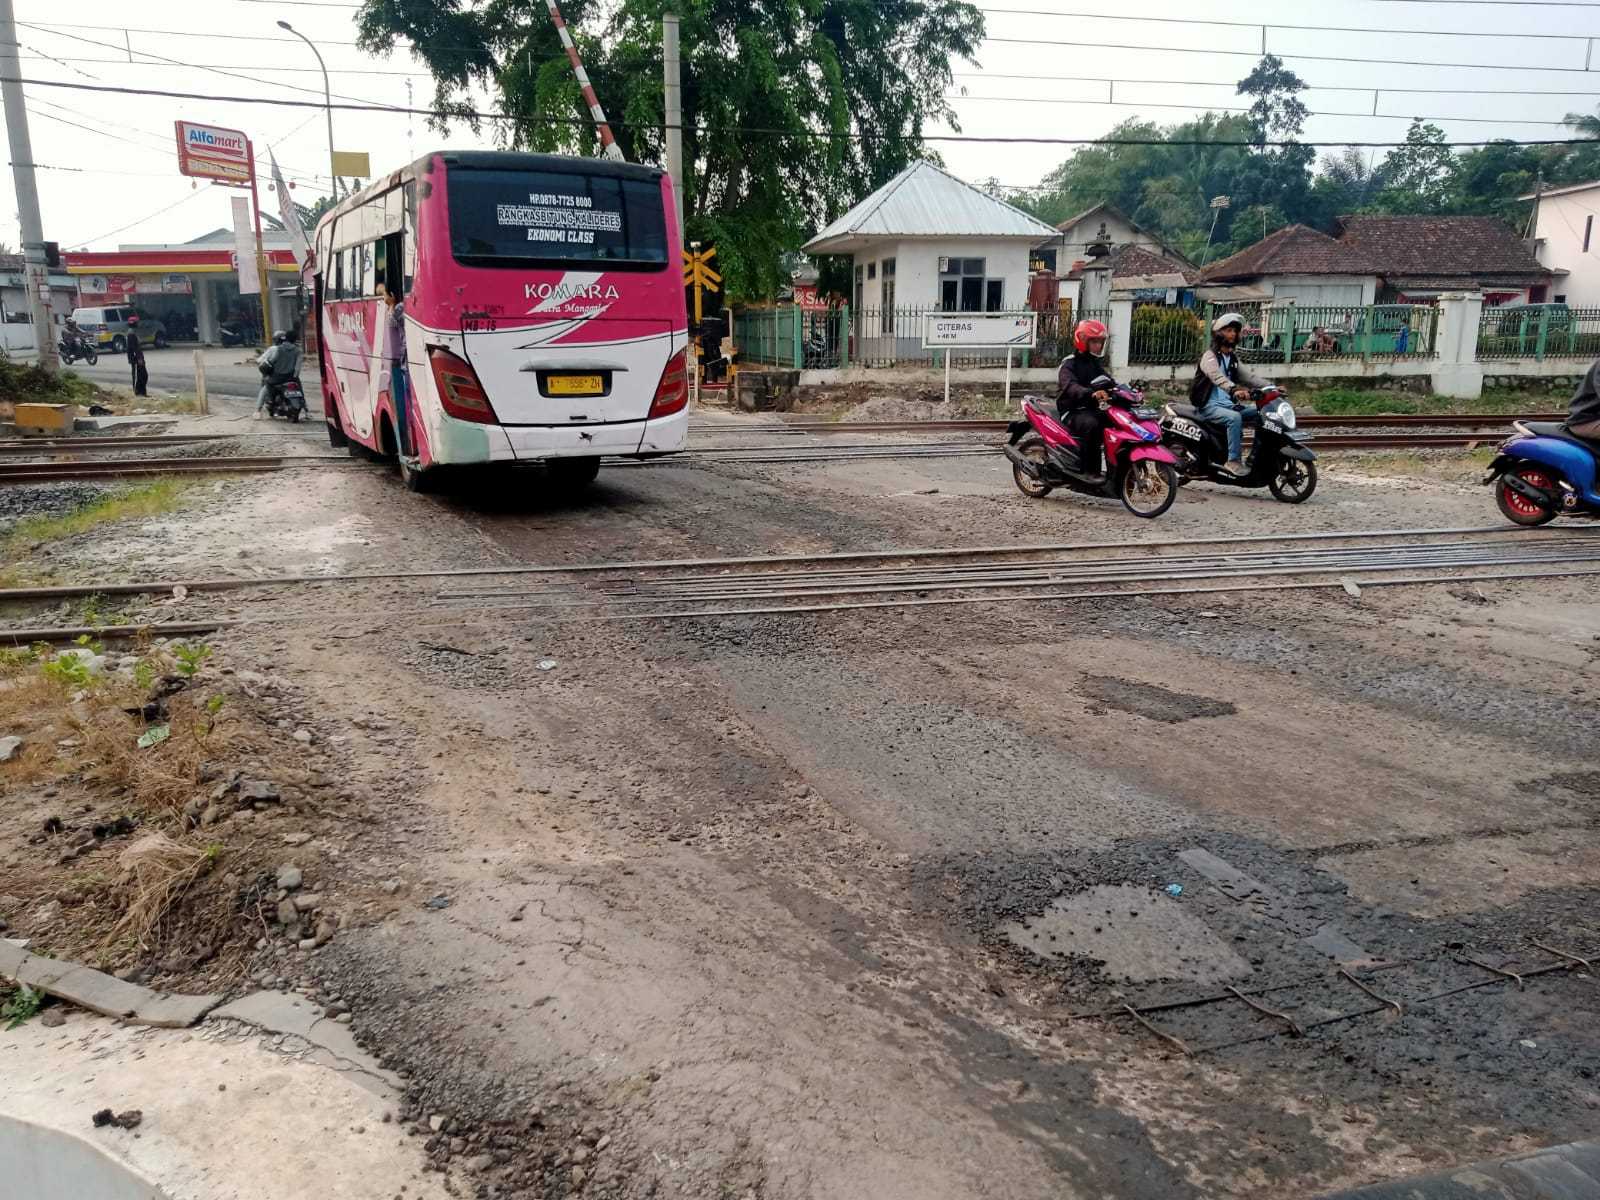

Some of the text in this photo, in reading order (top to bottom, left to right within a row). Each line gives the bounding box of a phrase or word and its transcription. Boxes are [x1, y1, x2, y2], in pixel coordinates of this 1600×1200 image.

[189, 129, 243, 149] Alfamart
[497, 206, 621, 229] RANGKASBITUNG-KALIDERES
[527, 228, 595, 244] EKONOMI CLASS
[524, 283, 619, 300] KOMARA
[936, 323, 972, 331] CITERAS
